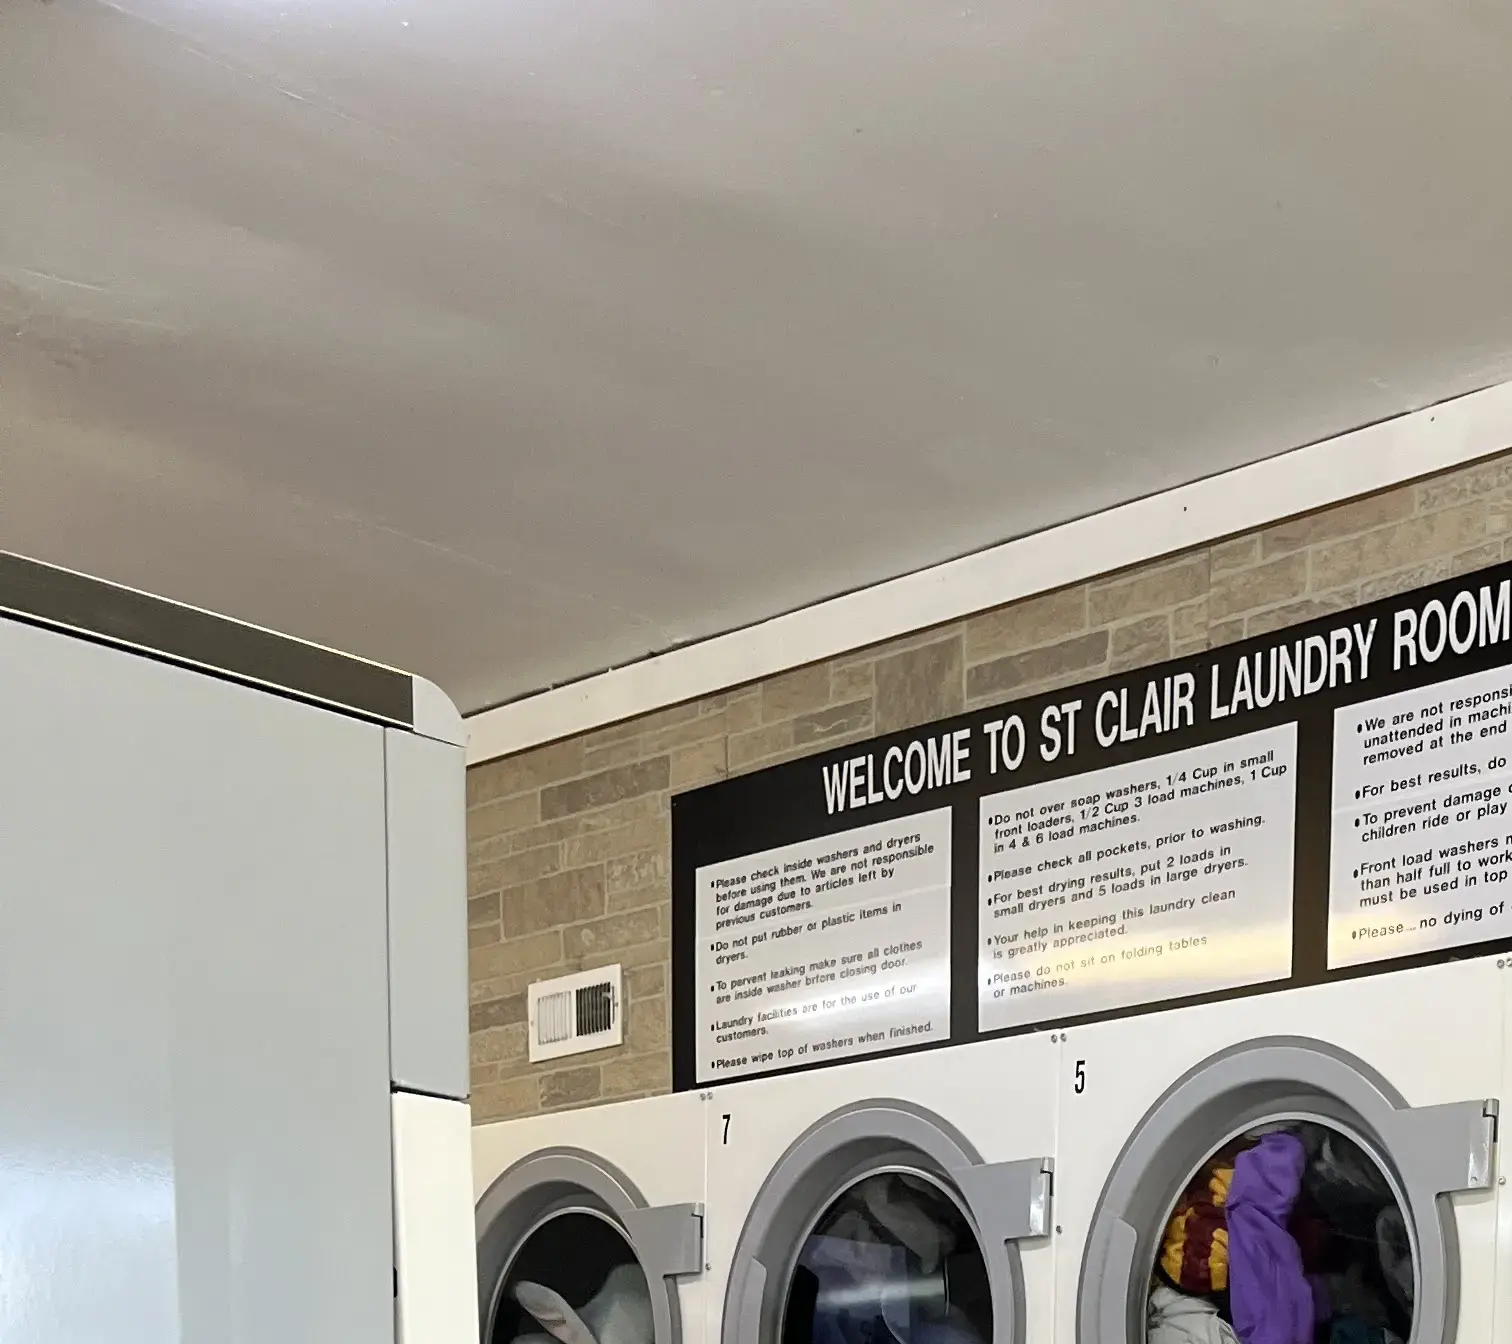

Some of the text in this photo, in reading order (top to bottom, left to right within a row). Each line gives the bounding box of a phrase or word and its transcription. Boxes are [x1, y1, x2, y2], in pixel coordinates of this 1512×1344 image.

[822, 579, 1512, 815] WELCOME TO ST CLAIR LAUNDRY ROOM
[1364, 717, 1386, 730] We
[1391, 711, 1415, 724] are
[1420, 701, 1444, 718] not
[1362, 739, 1424, 765] removed
[1429, 735, 1444, 749] at
[1449, 731, 1473, 744] the
[1479, 719, 1507, 737] end
[1363, 717, 1444, 748] unattended
[1448, 715, 1462, 728] in
[993, 814, 1011, 825] Do
[1014, 807, 1035, 820] not
[1038, 802, 1066, 815] over
[1070, 794, 1101, 808] soap
[1165, 771, 1187, 786] 1/4
[1191, 766, 1218, 781] Cup
[1222, 762, 1235, 773] in
[1239, 751, 1274, 768] small
[1362, 784, 1385, 797] For
[1390, 774, 1421, 791] best
[1428, 763, 1482, 784] results,
[1488, 756, 1506, 769] do
[994, 824, 1023, 838] front
[1079, 803, 1100, 819] 1/2
[1104, 801, 1129, 814] Cup
[1133, 796, 1143, 807] 3
[1147, 788, 1175, 804] load
[1251, 769, 1256, 780] 1
[1260, 764, 1287, 778] Cup
[1361, 821, 1416, 842] children
[1422, 813, 1449, 829] ride
[1456, 809, 1471, 821] or
[1477, 800, 1507, 820] play
[1362, 812, 1378, 825] To
[1383, 798, 1437, 823] prevent
[1442, 786, 1502, 808] damage
[993, 866, 1033, 881] Please
[1036, 855, 1073, 871] check
[1077, 850, 1092, 863] all
[1155, 832, 1187, 848] prior
[1190, 828, 1205, 838] to
[994, 843, 1004, 853] in
[1008, 838, 1016, 849] 4
[1021, 836, 1030, 847] &
[1035, 832, 1044, 844] 6
[1048, 825, 1074, 841] load
[1360, 857, 1395, 875] Front
[1402, 848, 1432, 866] load
[1438, 838, 1498, 858] washers
[715, 888, 746, 902] before
[750, 881, 776, 894] using
[811, 868, 825, 880] We
[830, 865, 846, 875] are
[850, 857, 867, 871] not
[872, 843, 934, 869] responsible
[716, 833, 920, 888] Please check inside washers and dryers
[993, 892, 1013, 904] For
[1016, 884, 1043, 899] best
[1048, 877, 1085, 892] drying
[1140, 859, 1161, 876] put
[1166, 856, 1175, 868] 2
[1179, 848, 1214, 865] loads
[1219, 846, 1231, 856] in
[1359, 877, 1391, 890] than
[1395, 867, 1423, 884] half
[1428, 861, 1451, 877] full
[1456, 859, 1472, 871] to
[716, 867, 894, 916] for damage due to articles left by
[1359, 890, 1394, 907] must
[1399, 887, 1418, 899] be
[1423, 876, 1459, 894] used
[1464, 875, 1477, 887] in
[1483, 869, 1508, 883] top
[715, 913, 755, 931] previous
[1419, 917, 1437, 928] no
[1443, 908, 1483, 925] dying
[1489, 900, 1504, 915] of
[1074, 1059, 1086, 1094] 5
[722, 1113, 731, 1145] 7
